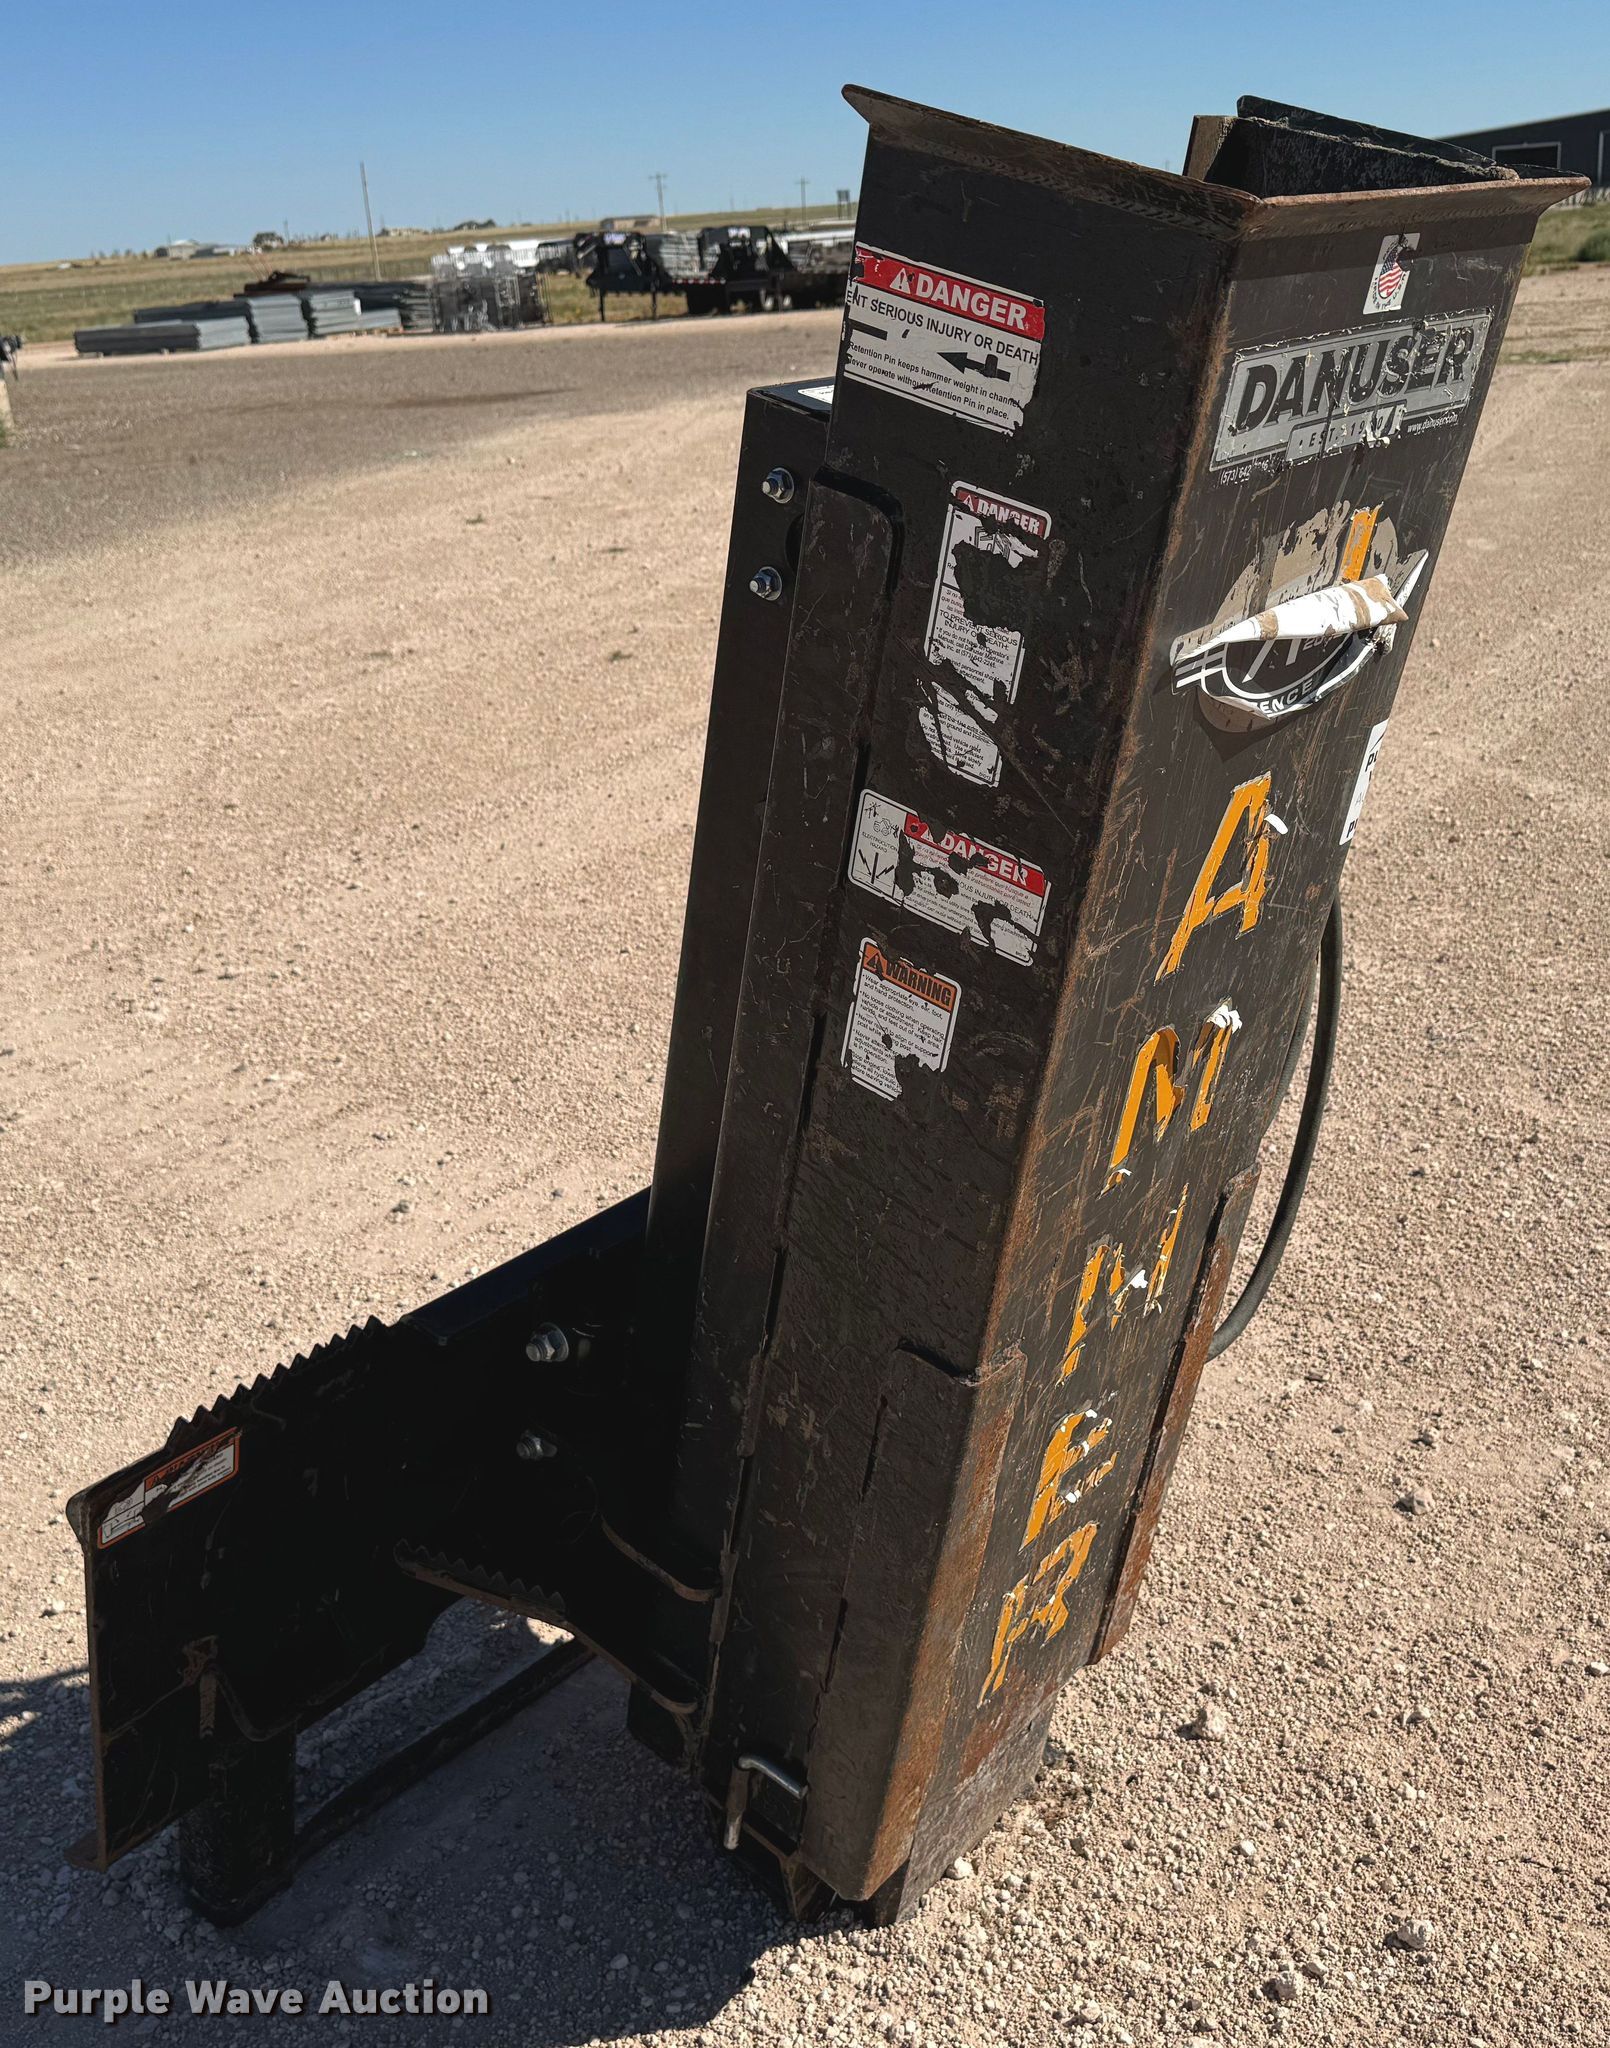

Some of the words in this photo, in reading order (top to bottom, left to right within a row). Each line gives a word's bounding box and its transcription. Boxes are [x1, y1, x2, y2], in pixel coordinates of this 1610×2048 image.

[915, 273, 1027, 331] DANGER
[870, 298, 923, 327] SERIOUS
[926, 317, 971, 342] INJURY
[974, 334, 993, 350] OR
[995, 340, 1040, 366] DEATH
[849, 341, 882, 362] Retention
[883, 353, 896, 365] Pin
[897, 358, 920, 374] keeps
[920, 365, 952, 384] hammer
[952, 376, 979, 396] weight
[979, 385, 987, 397] in
[1232, 327, 1475, 435] DANUSER
[868, 364, 896, 381] operate
[963, 396, 976, 409] Pin
[977, 400, 985, 412] in
[986, 405, 1010, 421] place.
[1350, 416, 1385, 437] 190
[977, 498, 1040, 535] DANGER
[939, 609, 950, 619] TO
[950, 613, 984, 633] PREVENT
[985, 628, 1018, 646] SERIOUS
[944, 619, 970, 636] INJURY
[864, 981, 873, 990] and
[874, 986, 887, 997] hand
[886, 962, 952, 1007] WARNING
